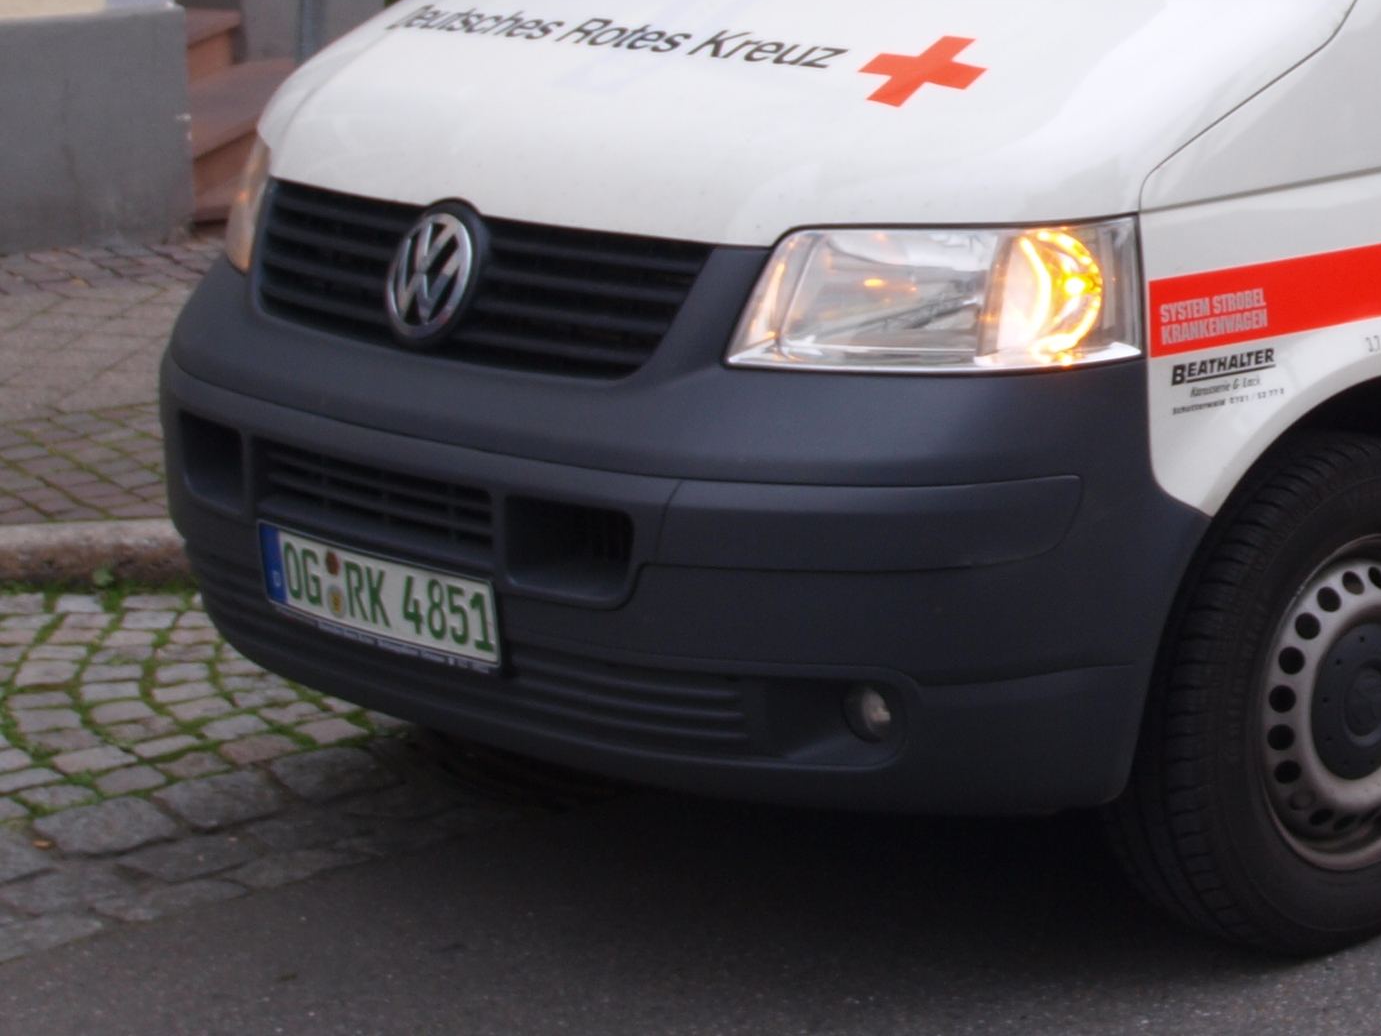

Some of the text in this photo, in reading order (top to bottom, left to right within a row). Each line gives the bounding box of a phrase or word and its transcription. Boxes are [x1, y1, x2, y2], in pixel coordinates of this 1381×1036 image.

[386, 4, 849, 69] Deutsches Rotes Kreuz
[1160, 287, 1267, 324] SYSTEM STROBEL
[1161, 307, 1269, 346] KRANKENWAGEN
[1172, 348, 1275, 386] BEATHALTER
[284, 541, 323, 607] OG
[344, 561, 391, 628] RK
[402, 575, 494, 653] 4851
